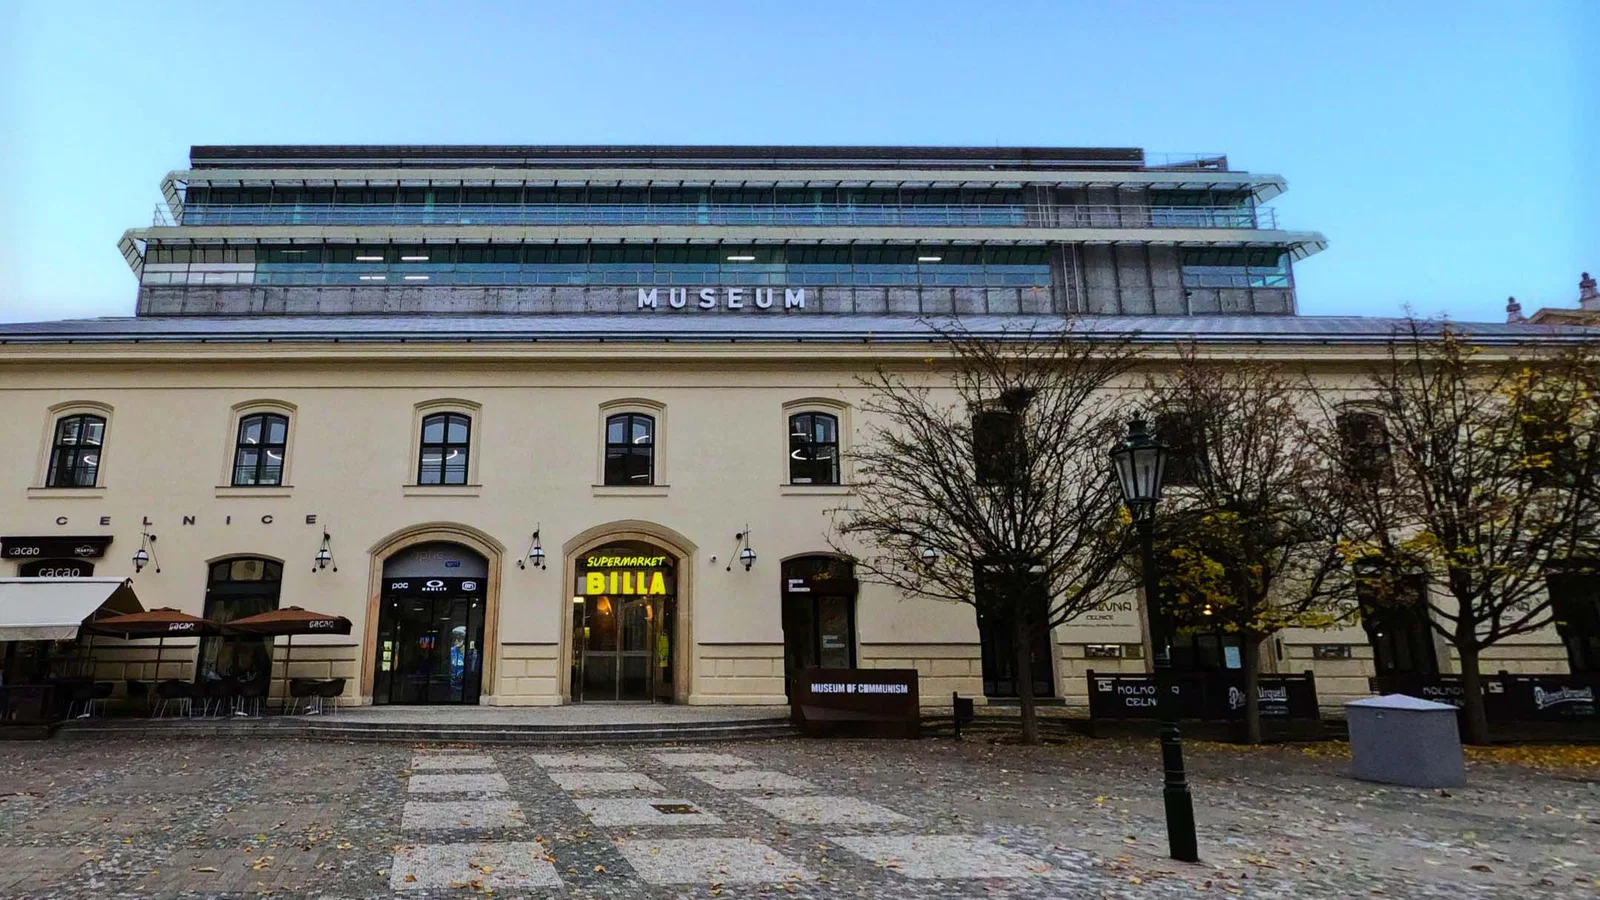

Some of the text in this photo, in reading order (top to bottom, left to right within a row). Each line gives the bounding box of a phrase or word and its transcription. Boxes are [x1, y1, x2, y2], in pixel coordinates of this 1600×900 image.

[637, 288, 806, 308] MUSEUM
[56, 514, 317, 526] CELNICE
[9, 547, 40, 555] cacao
[587, 556, 666, 567] SUPERMARKET
[38, 568, 81, 578] cacao
[586, 571, 667, 595] BILLA
[811, 684, 908, 693] MUSEUM OF COMMUNISM
